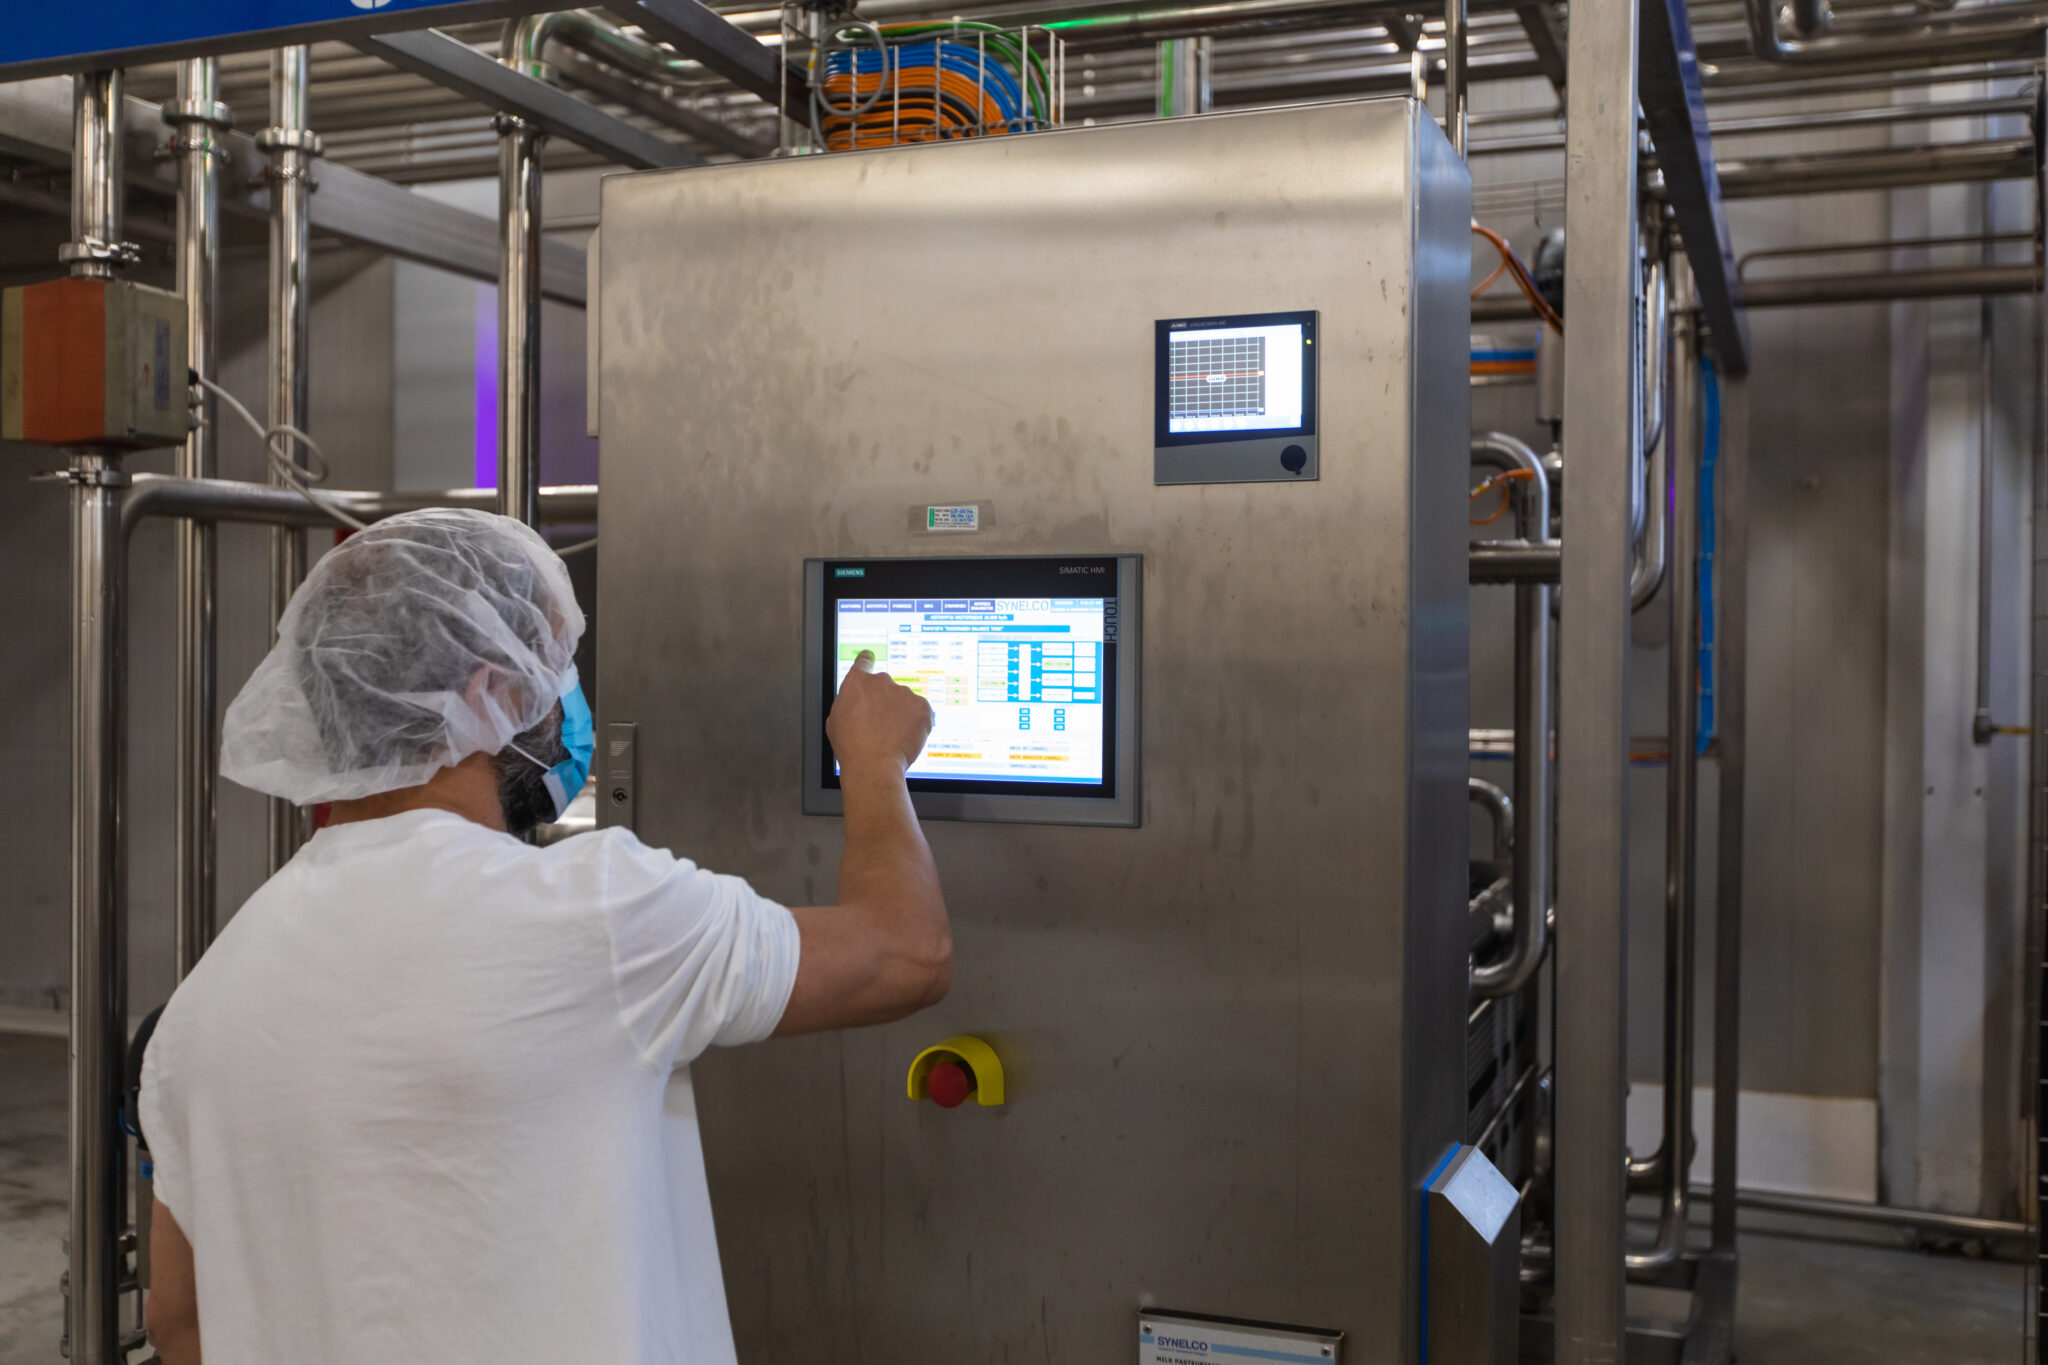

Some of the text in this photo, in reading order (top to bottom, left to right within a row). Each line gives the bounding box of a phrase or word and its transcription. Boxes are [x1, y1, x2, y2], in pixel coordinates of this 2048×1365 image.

[1059, 566, 1106, 575] SIMATIC HMI
[996, 600, 1049, 611] SYNELCO
[1104, 599, 1118, 642] TOUCH
[1158, 1336, 1208, 1352] SYNELCO
[1156, 1356, 1173, 1364] MILK
